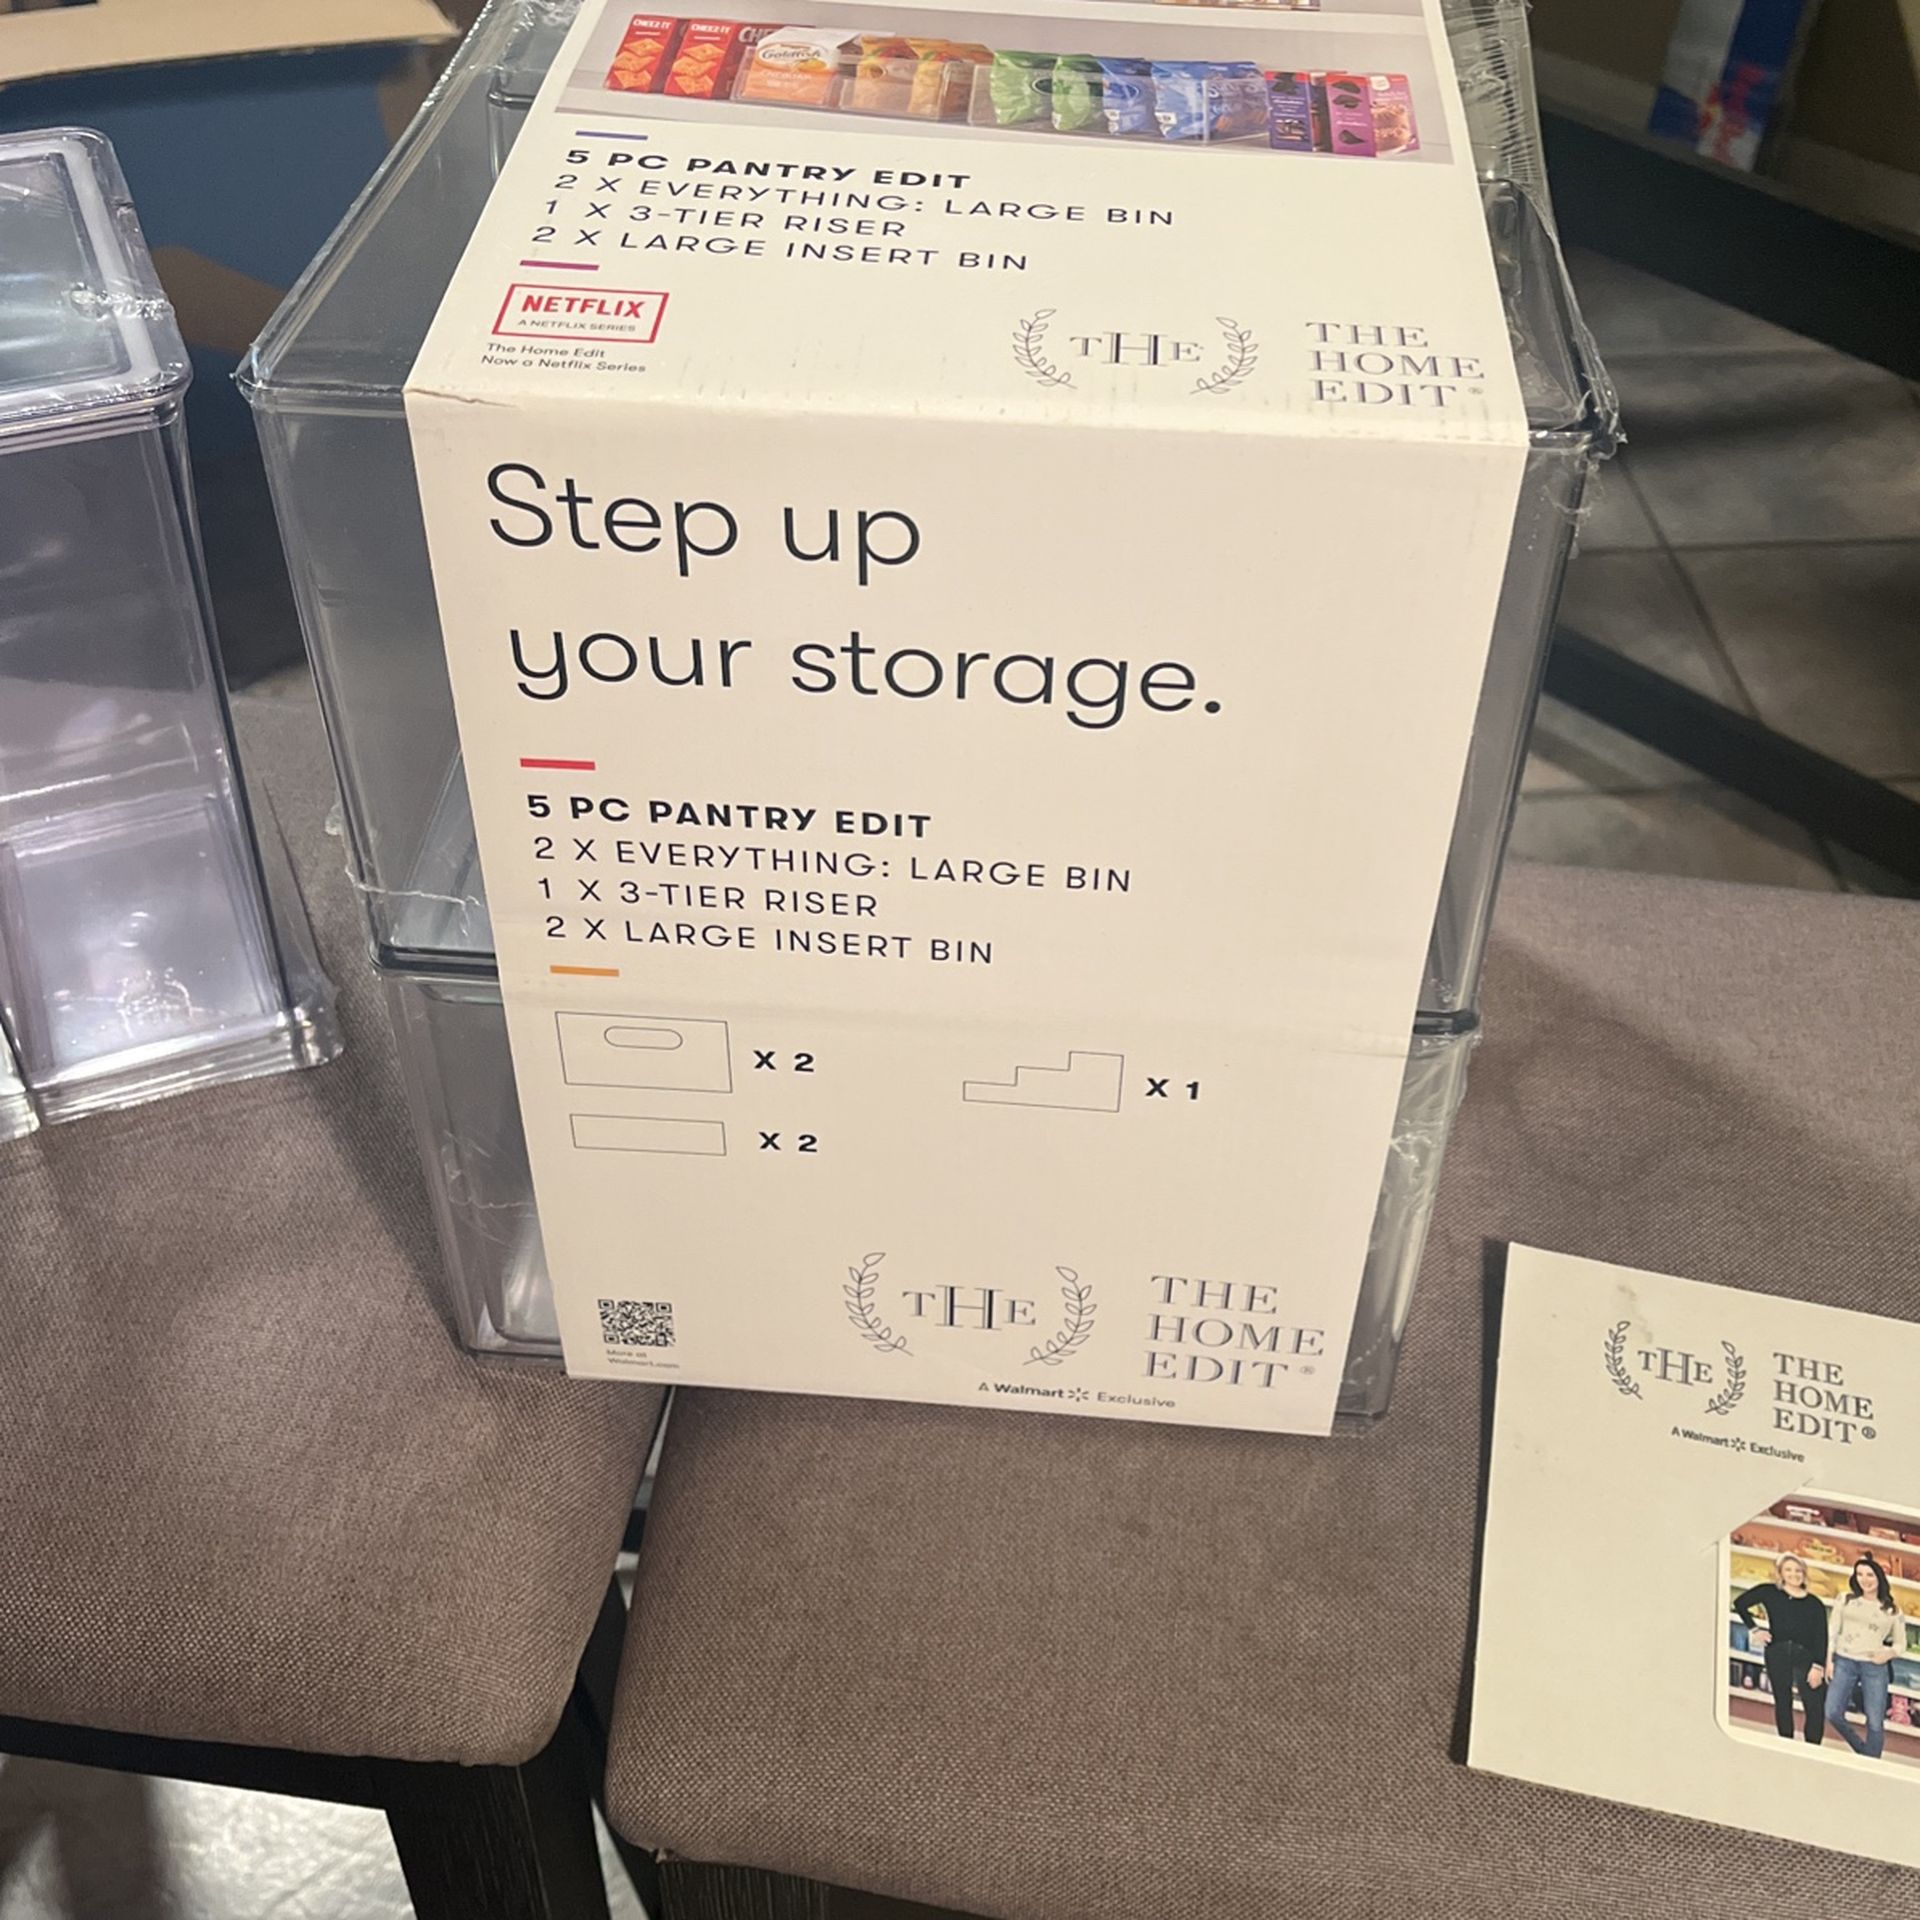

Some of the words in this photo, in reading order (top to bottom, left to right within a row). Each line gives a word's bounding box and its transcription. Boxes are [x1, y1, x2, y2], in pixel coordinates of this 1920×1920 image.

[566, 149, 590, 163] 5
[608, 152, 668, 169] PC
[687, 158, 857, 180] PANTRY
[873, 170, 971, 188] EDIT
[546, 200, 558, 215] 1
[585, 202, 612, 219] X
[629, 206, 764, 229] 3-TIER
[784, 215, 905, 237] RISER
[554, 174, 578, 189] 2
[596, 177, 622, 192] X
[640, 180, 923, 212] EVERYTHING:
[945, 199, 1085, 221] LARGE
[1107, 208, 1173, 225] BIN
[531, 226, 556, 242] 2
[574, 229, 601, 246] X
[620, 233, 766, 256] LARGE
[786, 242, 939, 265] INSERT
[958, 252, 1027, 270] BIN
[522, 295, 646, 318] NETFLIX
[530, 320, 586, 329] NETFLIX
[590, 323, 636, 332] SERIES
[1305, 322, 1428, 348] THE
[481, 355, 517, 365] Now
[522, 359, 533, 367] a
[538, 358, 592, 370] Netflix
[596, 361, 646, 373] Series
[487, 342, 516, 353] The
[520, 345, 569, 356] Home
[573, 348, 605, 358] Edit
[1070, 332, 1204, 367] THE
[1309, 350, 1485, 380] HOME
[486, 462, 738, 577] Step
[782, 505, 921, 586] up
[510, 628, 752, 701] your
[791, 631, 1222, 730] storage.
[527, 794, 551, 818] 5
[570, 796, 630, 822] PC
[649, 800, 816, 831] PANTRY
[836, 810, 931, 838] EDIT
[534, 837, 555, 859] 2
[573, 838, 597, 862] X
[617, 840, 890, 878] EVERYTHING:
[911, 856, 1045, 887] LARGE
[1066, 866, 1130, 892] BIN
[538, 877, 551, 899] 1
[578, 879, 602, 902] X
[620, 881, 745, 909] 3-TIER
[765, 889, 877, 917] RISER
[546, 916, 566, 938] 2
[584, 918, 607, 940] X
[625, 920, 755, 948] LARGE
[776, 928, 912, 958] INSERT
[931, 939, 992, 964] BIN
[753, 1050, 777, 1070] X
[794, 1053, 814, 1073] 2
[1144, 1077, 1170, 1098] X
[1186, 1081, 1200, 1100] 1
[758, 1131, 781, 1151] X
[798, 1134, 818, 1153] 2
[902, 1285, 1036, 1331] THE
[1151, 1274, 1278, 1315] THE
[1145, 1313, 1325, 1357] HOME
[1638, 1347, 1713, 1386] THE
[1773, 1352, 1844, 1386] THE
[978, 1382, 989, 1392] A
[993, 1383, 1064, 1398] Walmart
[1097, 1392, 1176, 1408] Exclusive
[1773, 1379, 1874, 1420] HOME
[1671, 1426, 1681, 1437] A
[1682, 1428, 1729, 1448] Walmart
[1750, 1442, 1805, 1463] Exclusive
